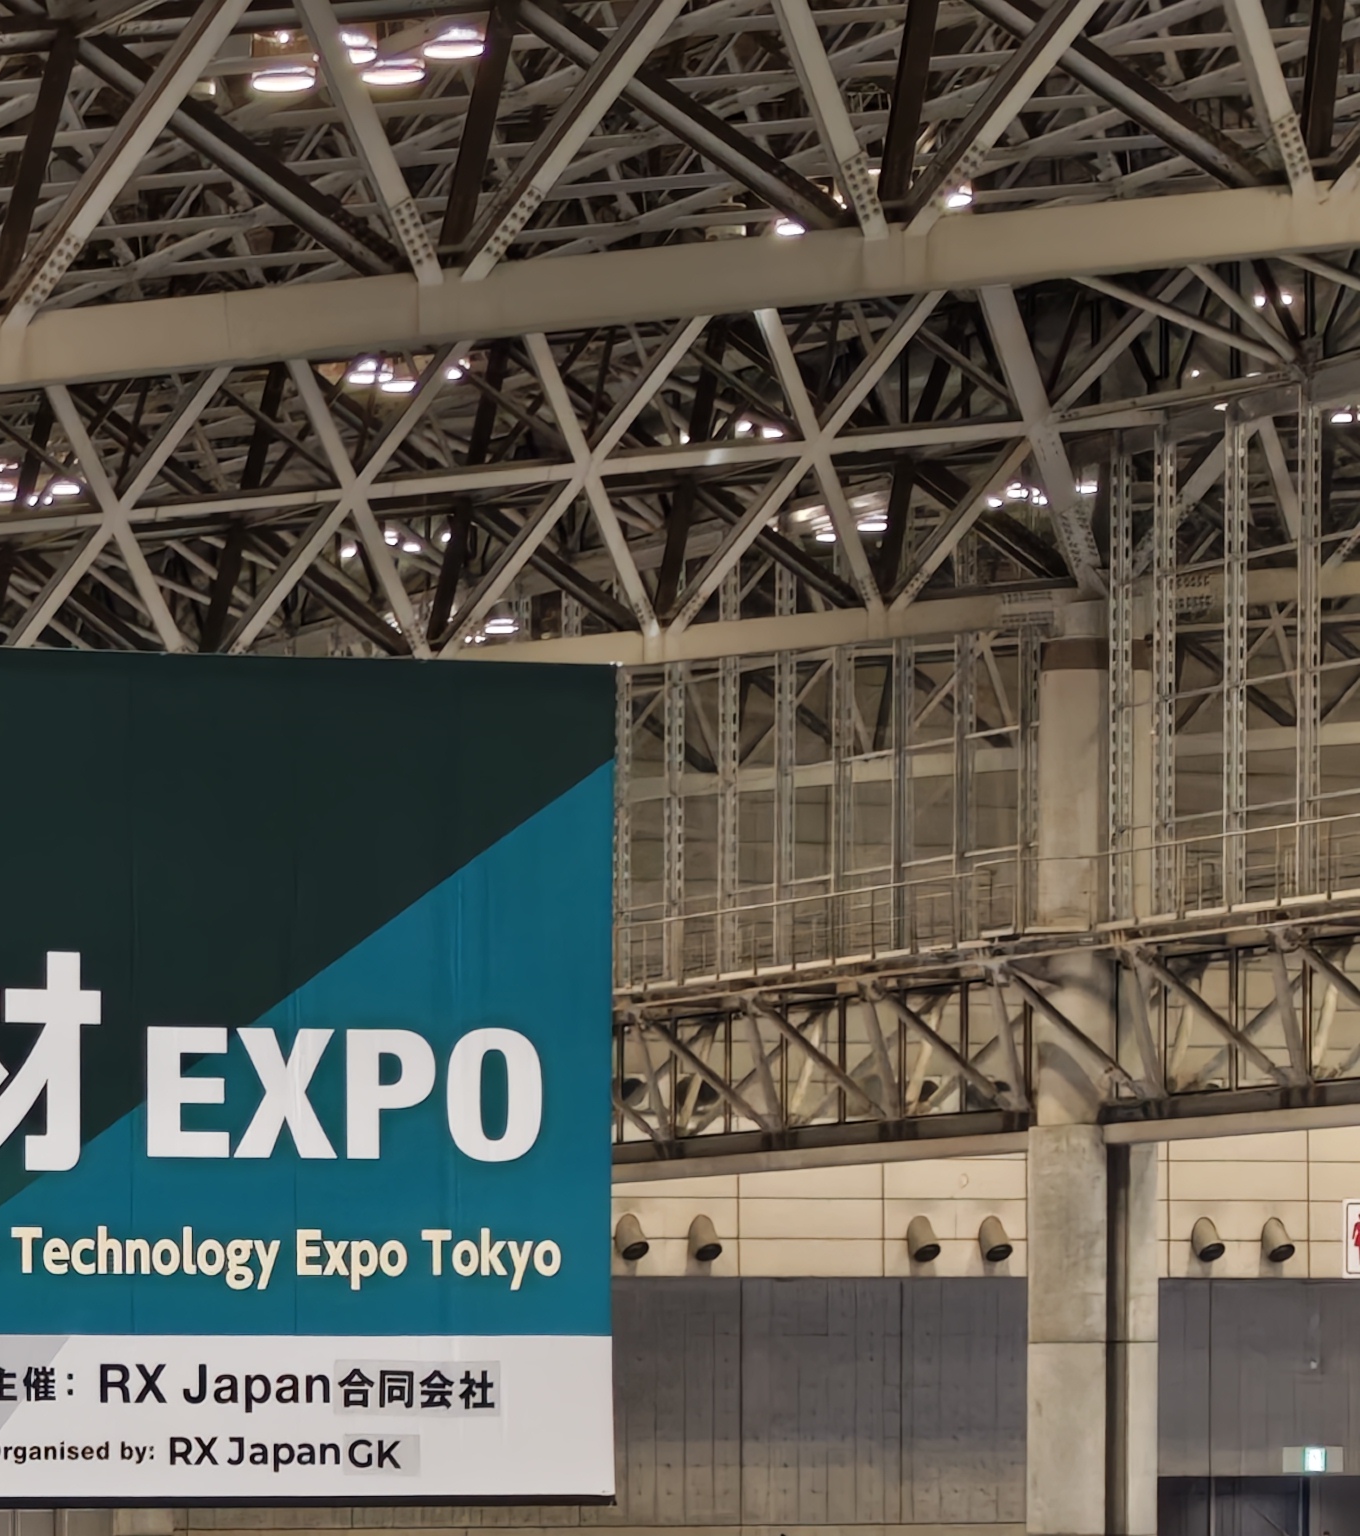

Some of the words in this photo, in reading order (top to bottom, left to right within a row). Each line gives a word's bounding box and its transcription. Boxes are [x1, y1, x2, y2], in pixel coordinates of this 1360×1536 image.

[146, 1026, 544, 1162] EXPO
[11, 1227, 281, 1291] Technology
[296, 1231, 408, 1290] Expo
[421, 1231, 562, 1290] Tokyo
[98, 1364, 168, 1405] RX
[120, 1439, 156, 1469] by:
[168, 1436, 219, 1467] RX
[228, 1437, 340, 1474] Japan
[348, 1440, 401, 1470] GK
